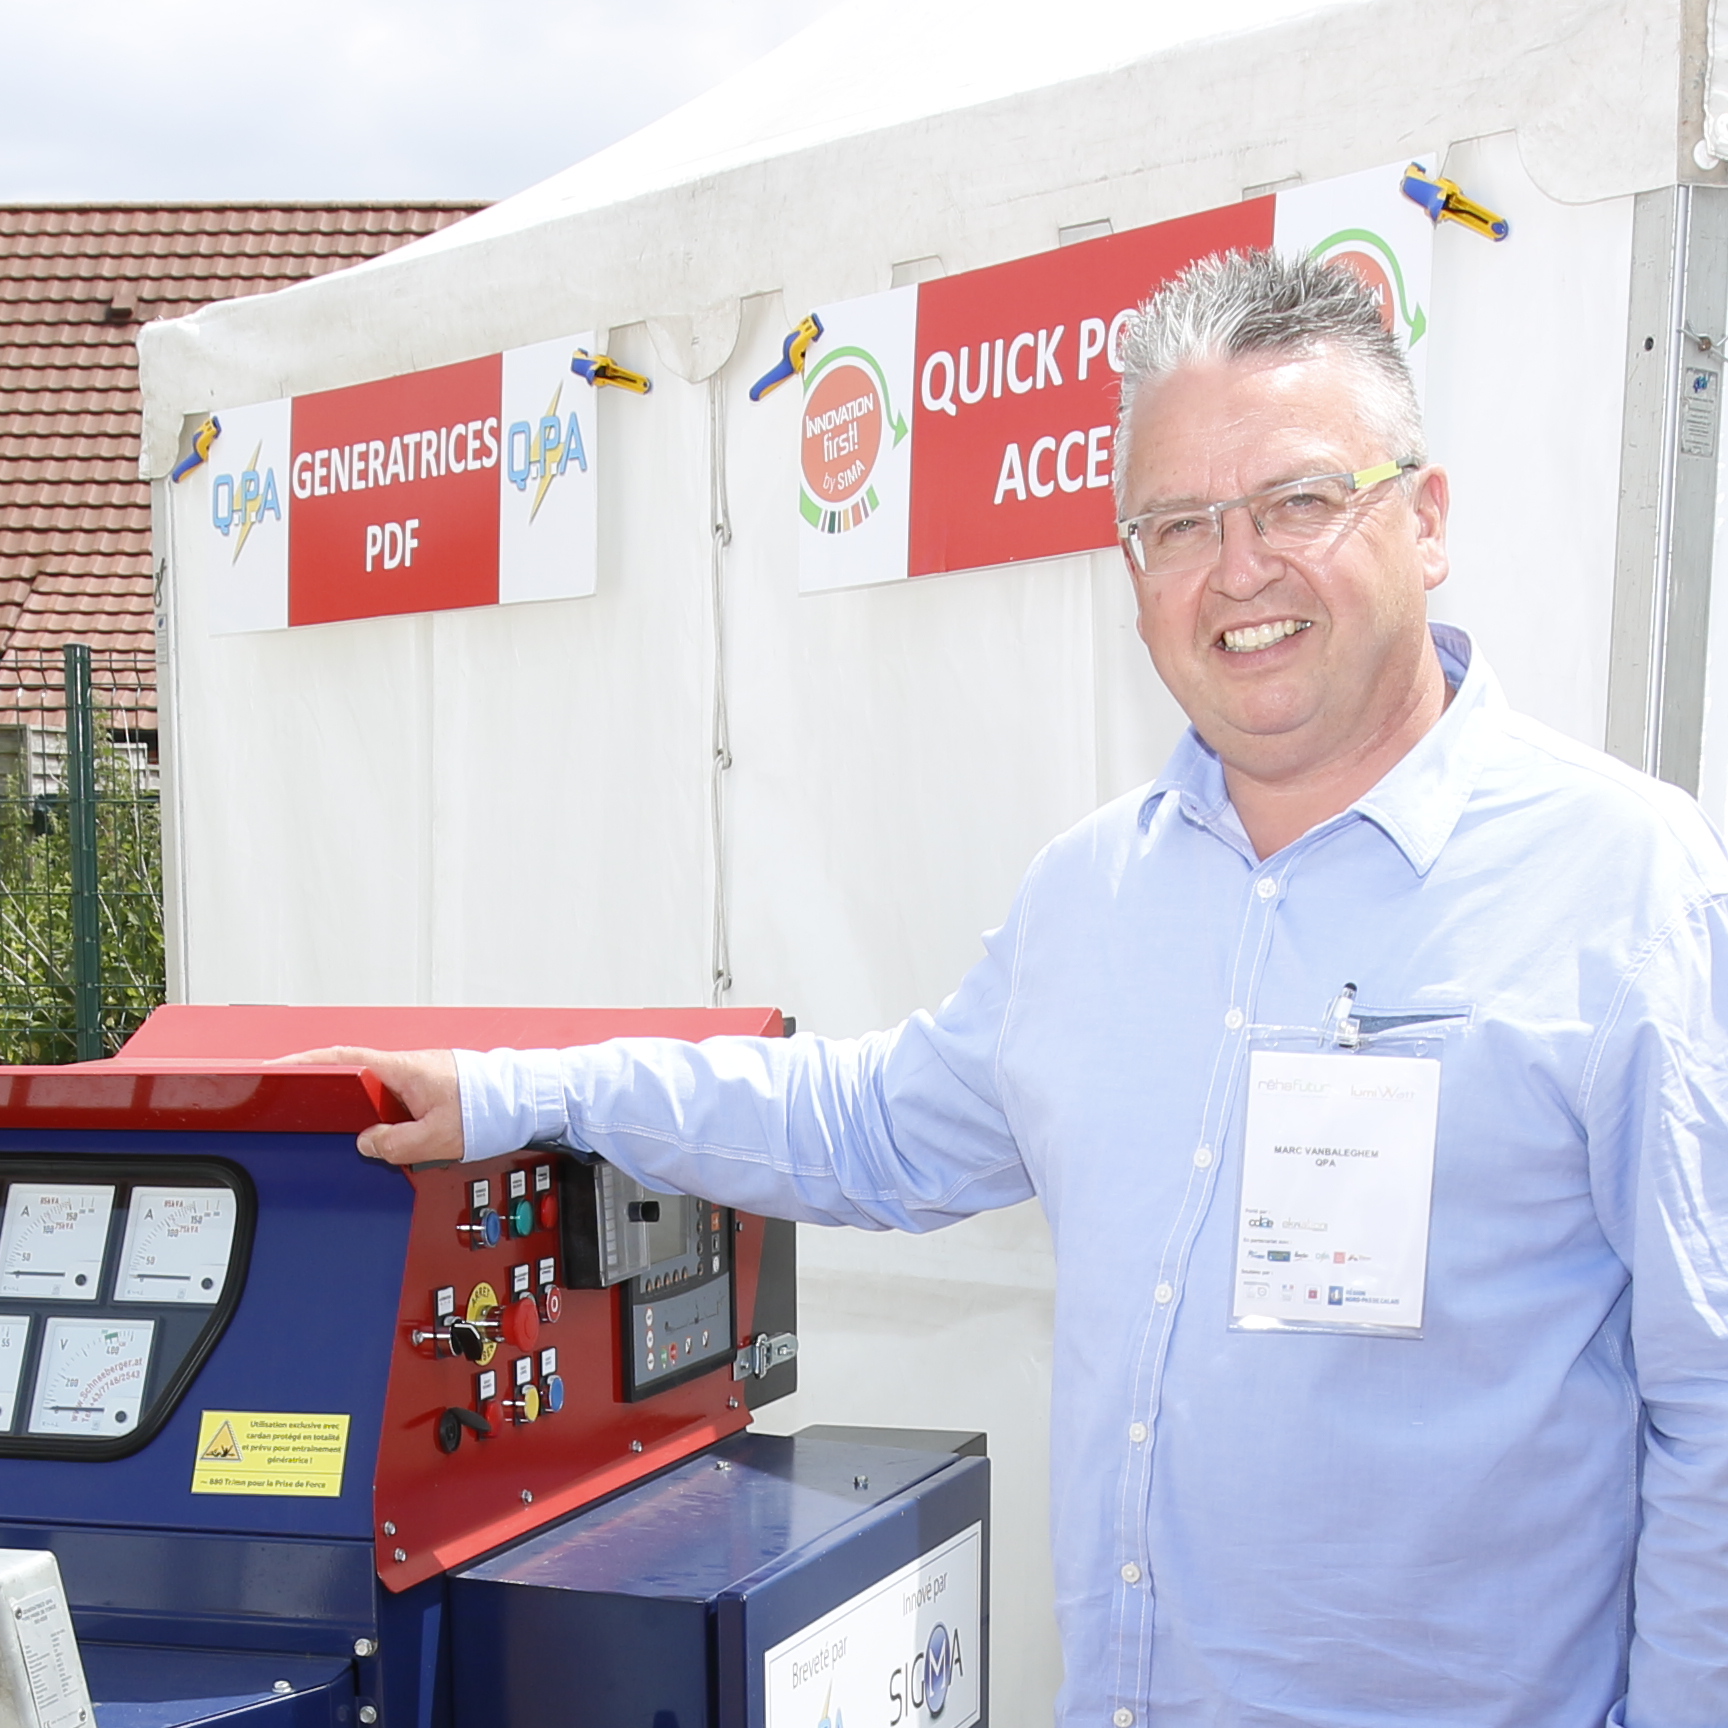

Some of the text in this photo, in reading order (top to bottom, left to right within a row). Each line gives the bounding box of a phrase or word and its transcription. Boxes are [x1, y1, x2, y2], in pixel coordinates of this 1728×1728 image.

[921, 324, 1066, 417] QUICK
[292, 417, 499, 499] GENERATRICES
[994, 424, 1119, 505] ACCE
[365, 518, 420, 573] PDF
[927, 1571, 948, 1604] par
[791, 1635, 849, 1689] Breveté par
